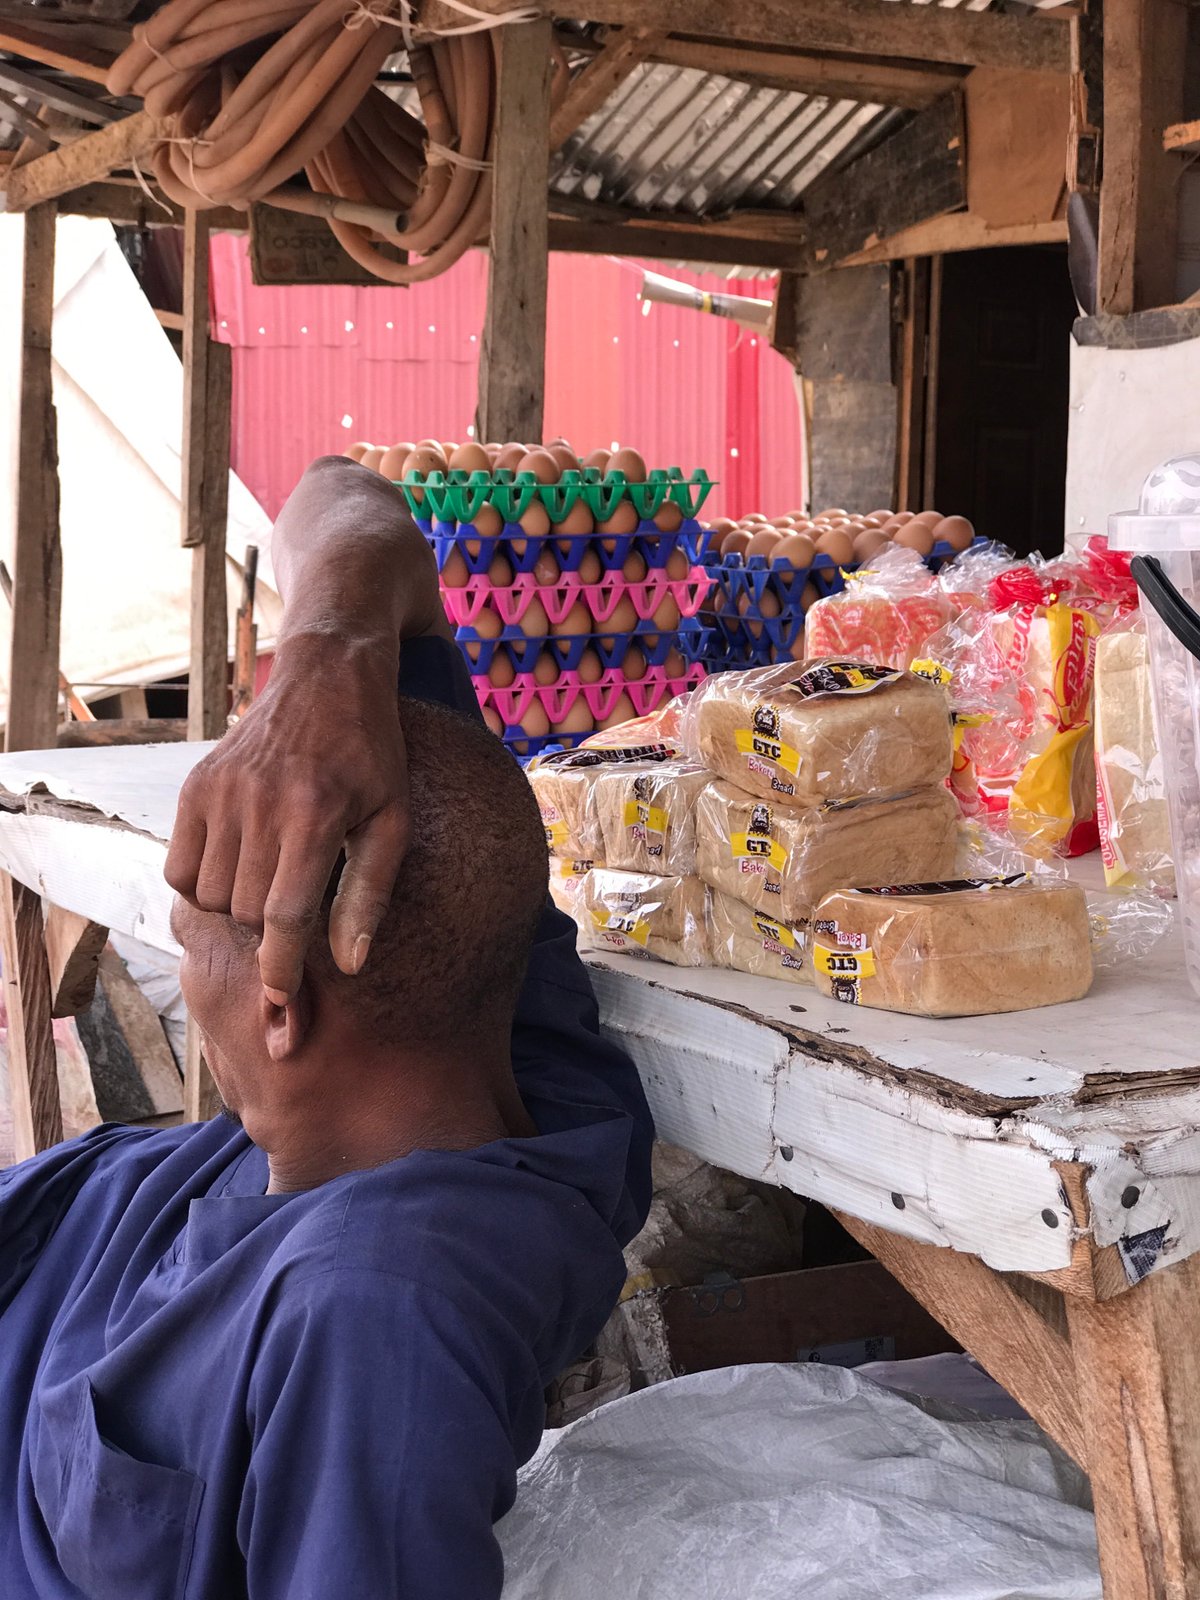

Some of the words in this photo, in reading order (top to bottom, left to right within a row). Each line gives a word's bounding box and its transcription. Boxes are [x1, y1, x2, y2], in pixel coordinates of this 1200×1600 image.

[753, 738, 781, 758] GTC
[771, 778, 795, 795] Bread
[741, 859, 766, 875] Bak
[763, 878, 781, 895] read
[757, 923, 780, 940] GTC
[782, 953, 804, 970] Bread
[826, 957, 857, 971] GTC
